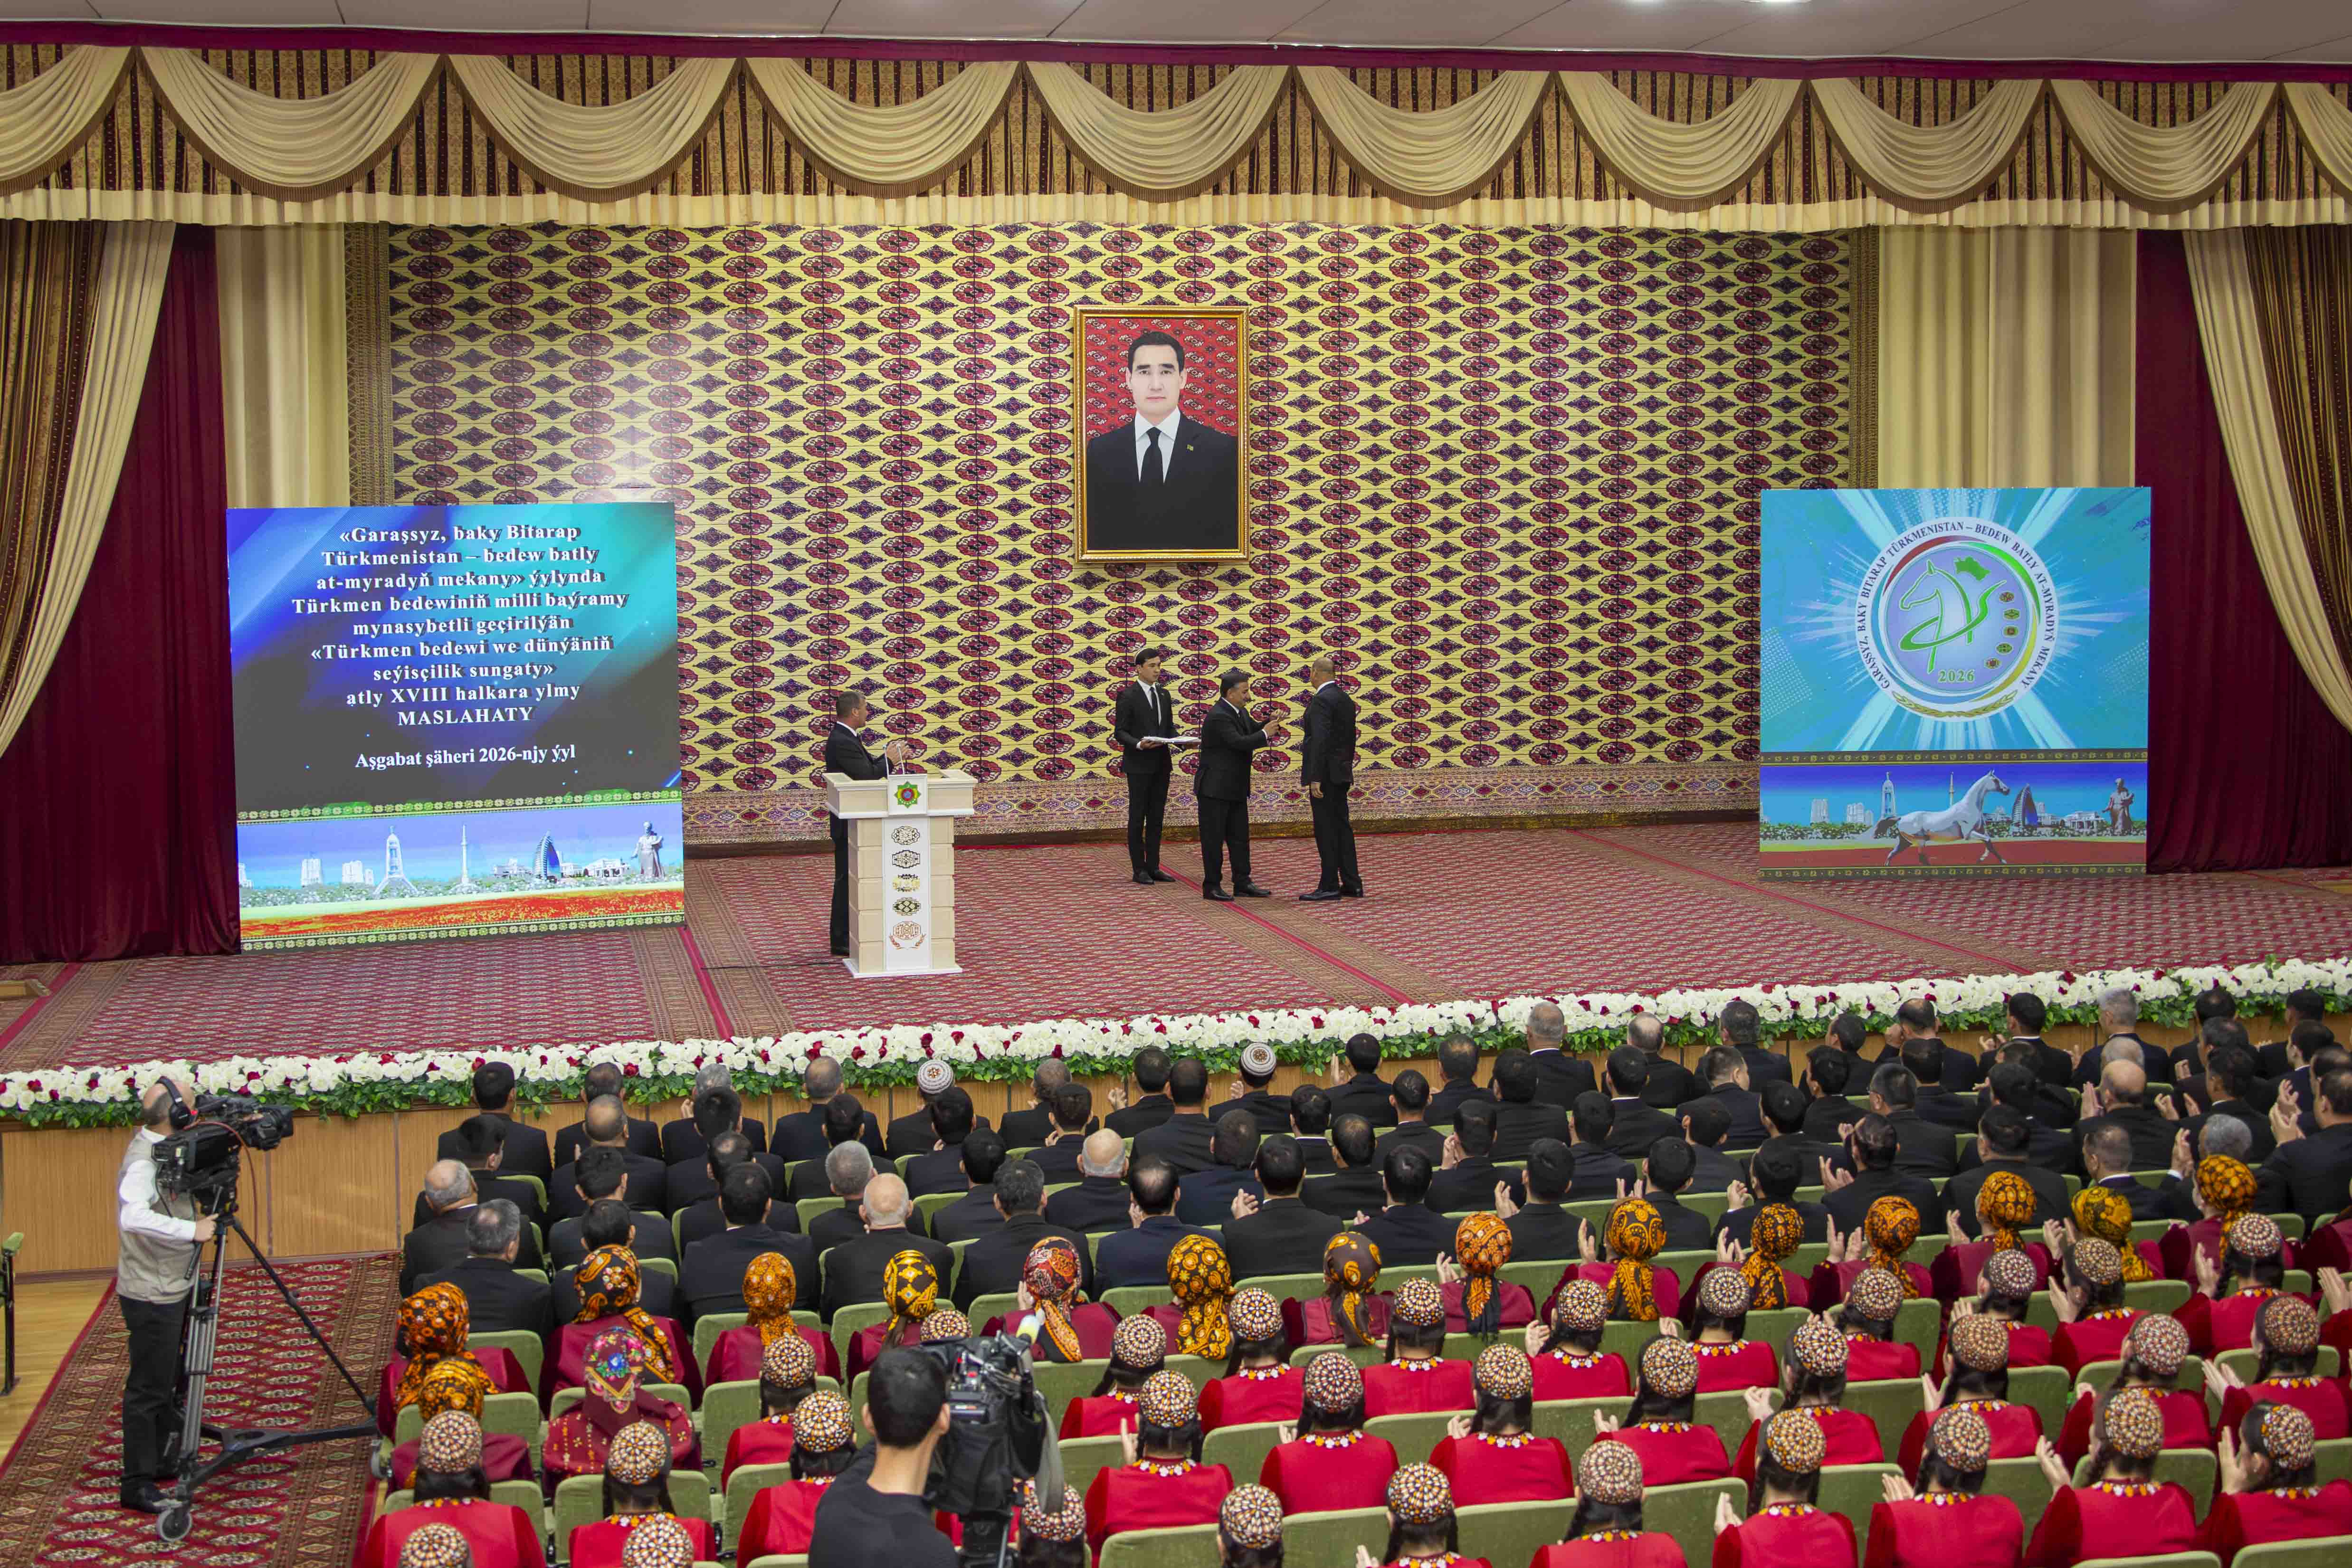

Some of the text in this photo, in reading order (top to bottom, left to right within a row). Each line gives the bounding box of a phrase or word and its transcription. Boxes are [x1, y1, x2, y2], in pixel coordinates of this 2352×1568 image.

[340, 525, 578, 544] «Garaşsyz, baky Bitarap
[1886, 521, 1964, 557] TÜRKMENISTAN
[1975, 524, 2011, 543] BEDEW
[322, 550, 461, 566] Türkmenistan
[484, 548, 543, 562] bedew
[549, 547, 596, 564] batly
[2011, 542, 2039, 570] BATLY
[317, 570, 601, 592] at-myradyň mekany» ýylynda
[1861, 556, 1887, 598] BITARAP
[292, 591, 626, 614] Türkmen bedewiniň milli baýramy
[2034, 573, 2055, 641] AT-MYRADYŇ
[353, 616, 571, 638] mynasybetli geçirilýän
[1857, 602, 1866, 631] BAKY
[311, 636, 610, 659] «Türkmen bedewi we dünýäniň
[373, 663, 553, 684] seýisçilik sungaty»
[1859, 636, 1890, 689] GARAŞSYZ,
[2021, 646, 2050, 688] MEKANY
[1938, 669, 1975, 683] 2026
[346, 684, 580, 707] atly XVIII halkara ylmy
[397, 707, 533, 725] MASLAHATY
[355, 744, 576, 770] Aşgabat şäheri 2026-njy ýyl
